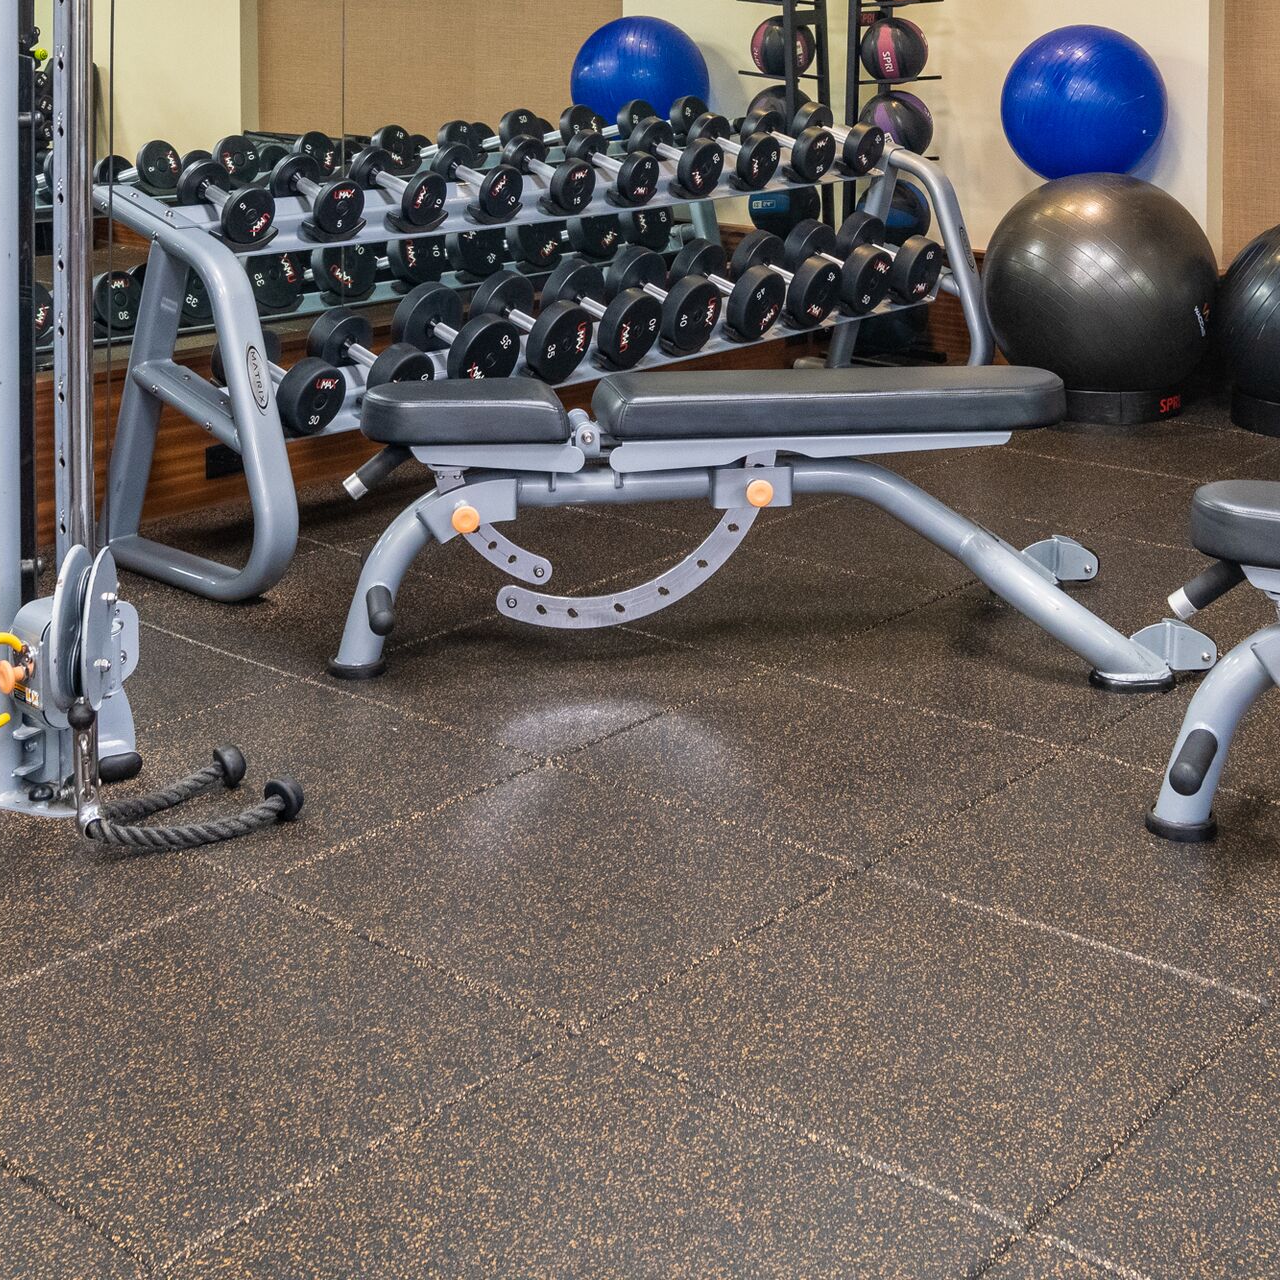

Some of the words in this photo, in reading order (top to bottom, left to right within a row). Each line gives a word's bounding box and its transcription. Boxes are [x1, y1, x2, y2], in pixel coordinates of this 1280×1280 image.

[882, 50, 895, 73] SPRI
[770, 150, 778, 162] 20
[816, 164, 824, 174] 25
[333, 188, 356, 201] UMAX
[573, 196, 581, 205] 15
[239, 202, 247, 210] 5
[433, 197, 443, 209] 10
[507, 196, 517, 207] 10
[336, 219, 343, 228] 5
[756, 287, 766, 301] 45
[862, 294, 871, 305] 50
[648, 317, 657, 332] 40
[679, 313, 688, 328] 40
[499, 334, 512, 350] 35
[575, 321, 587, 354] UMAX
[547, 343, 556, 359] 35
[250, 351, 266, 402] MATRIX
[316, 378, 339, 390] UMAX
[308, 415, 320, 425] 30
